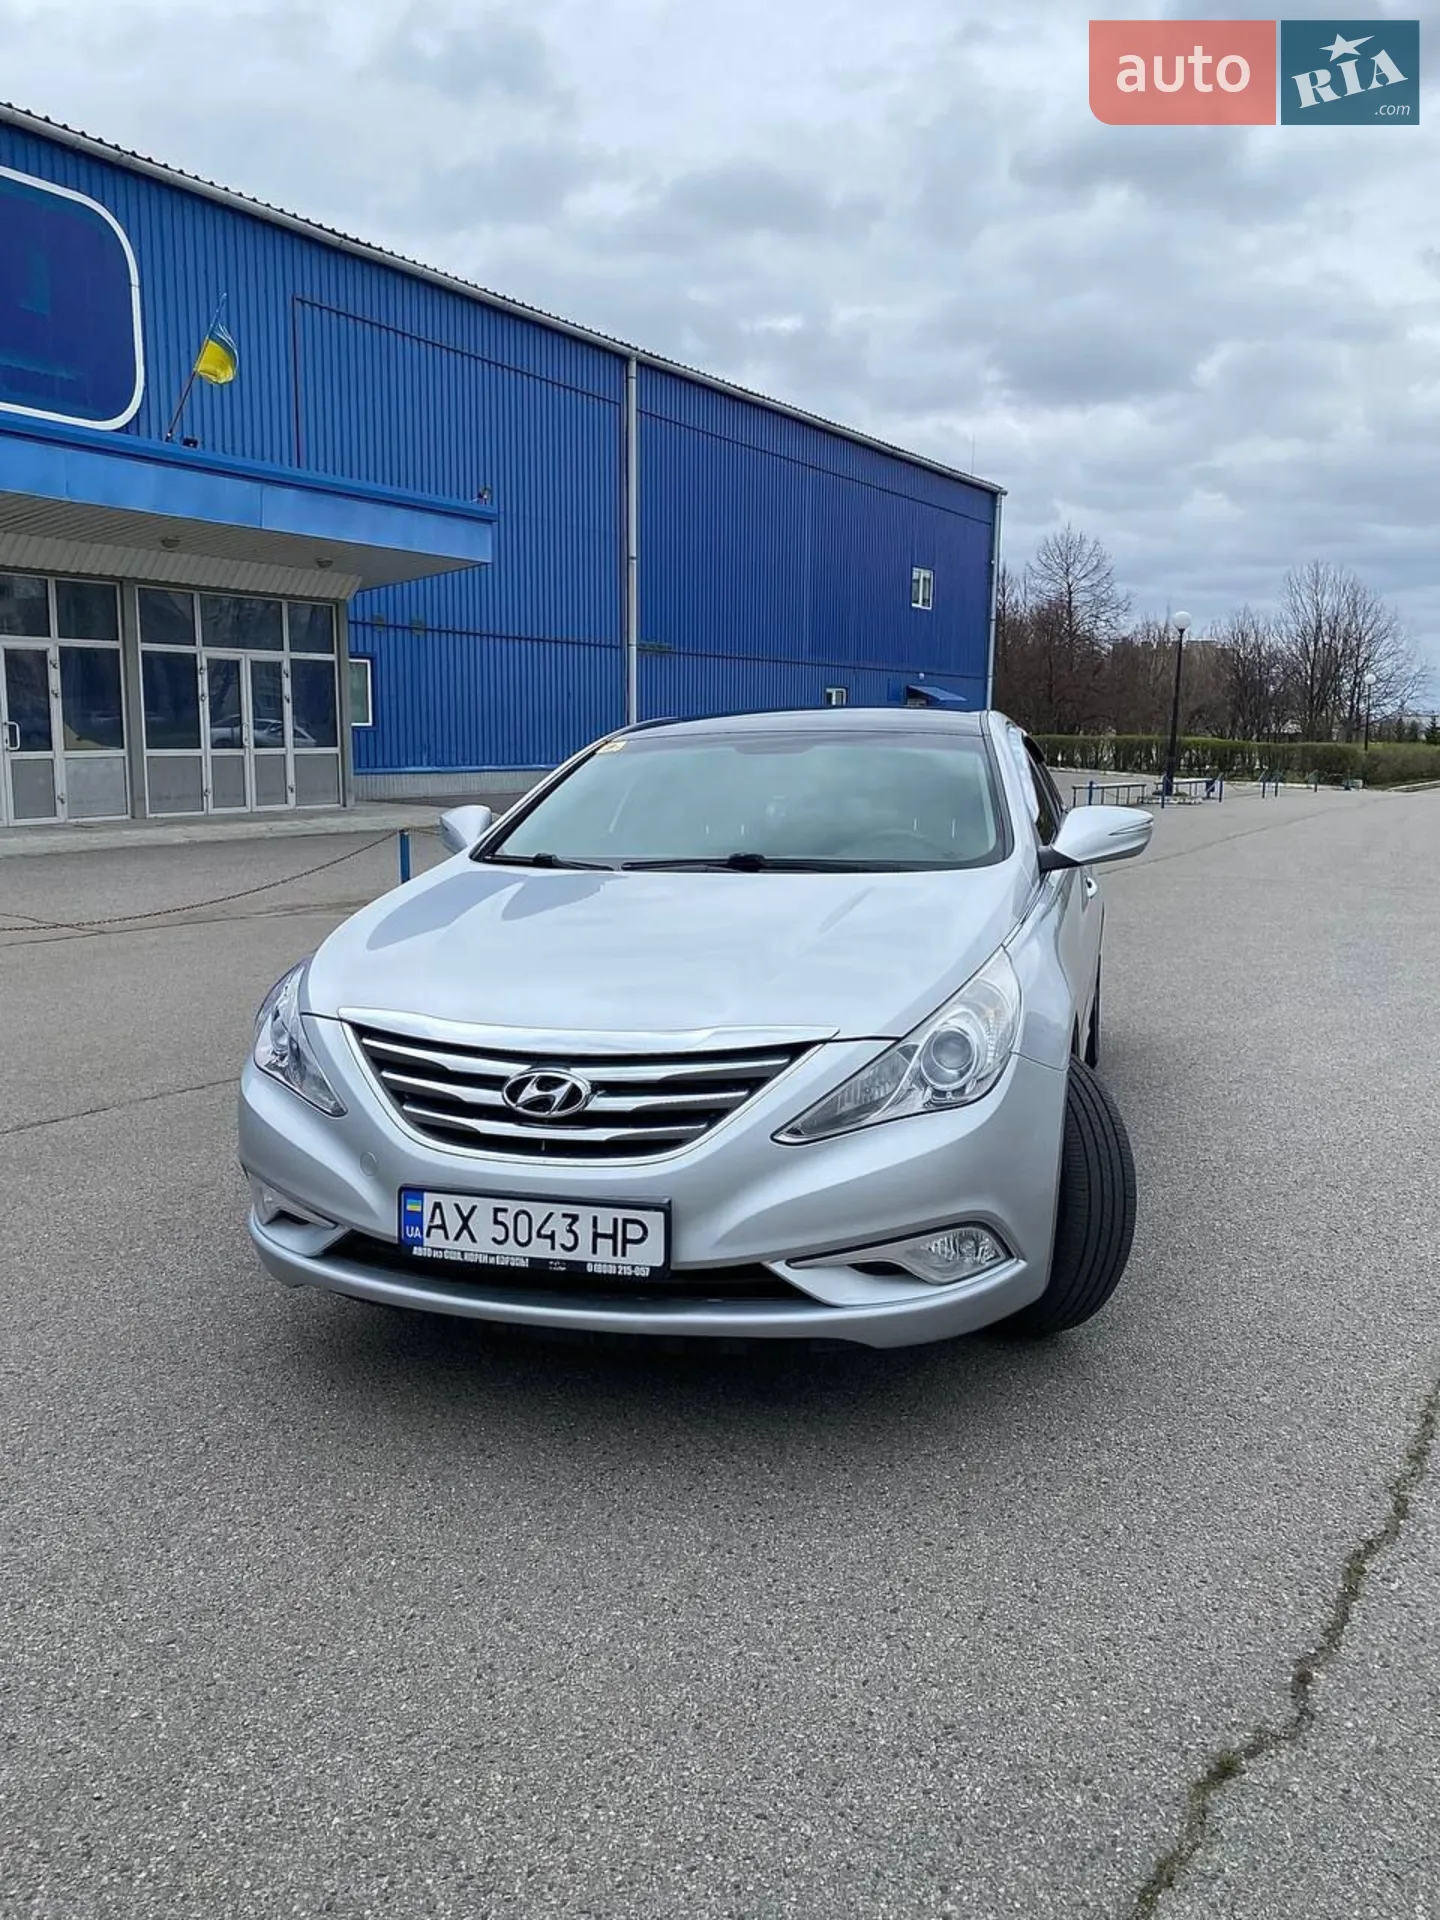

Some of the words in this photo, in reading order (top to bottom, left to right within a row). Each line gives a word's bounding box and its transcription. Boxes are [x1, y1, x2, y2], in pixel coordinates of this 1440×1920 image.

[405, 1225, 422, 1239] UA
[425, 1200, 478, 1244] AX
[490, 1207, 580, 1253] 5043
[591, 1215, 649, 1258] HP
